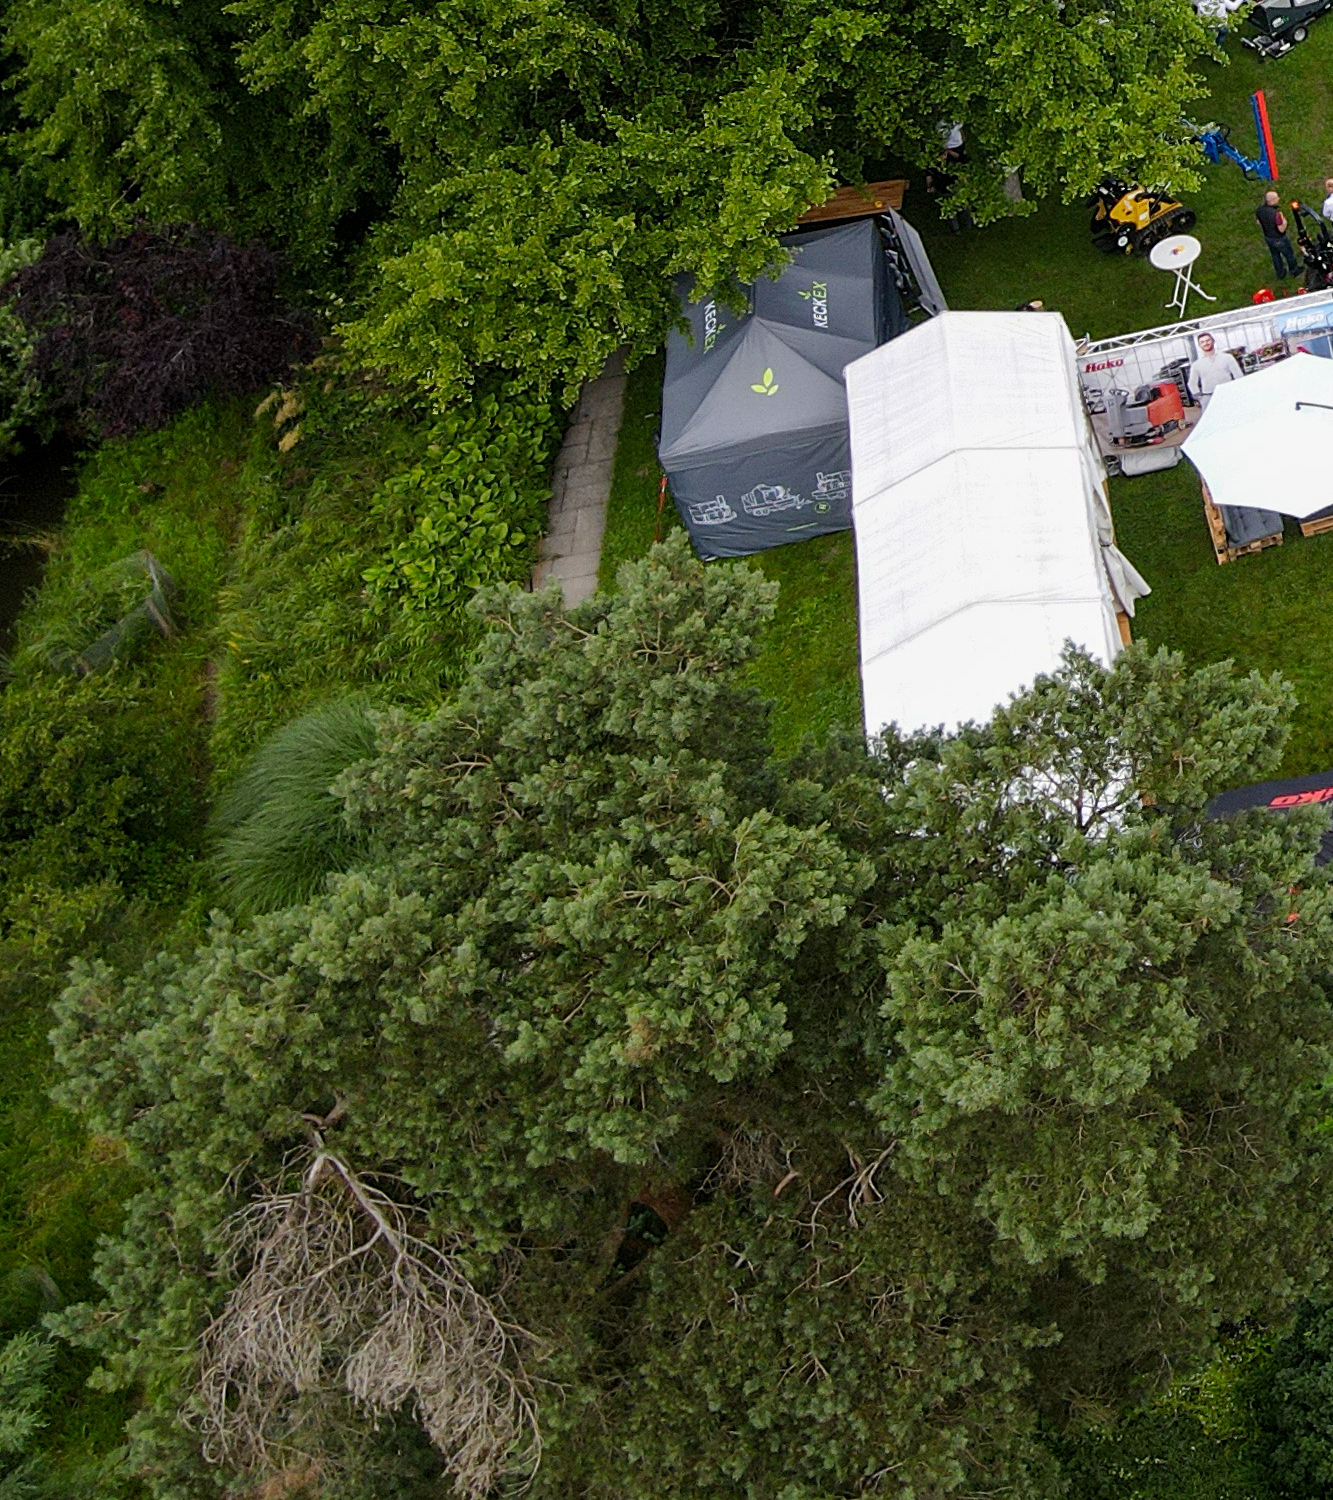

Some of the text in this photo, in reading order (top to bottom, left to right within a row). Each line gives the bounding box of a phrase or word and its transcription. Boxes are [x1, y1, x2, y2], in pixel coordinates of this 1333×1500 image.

[812, 280, 829, 329] KECKEX
[1285, 311, 1326, 330] Hako
[703, 299, 717, 355] KECKEX
[1085, 358, 1124, 373] Hako
